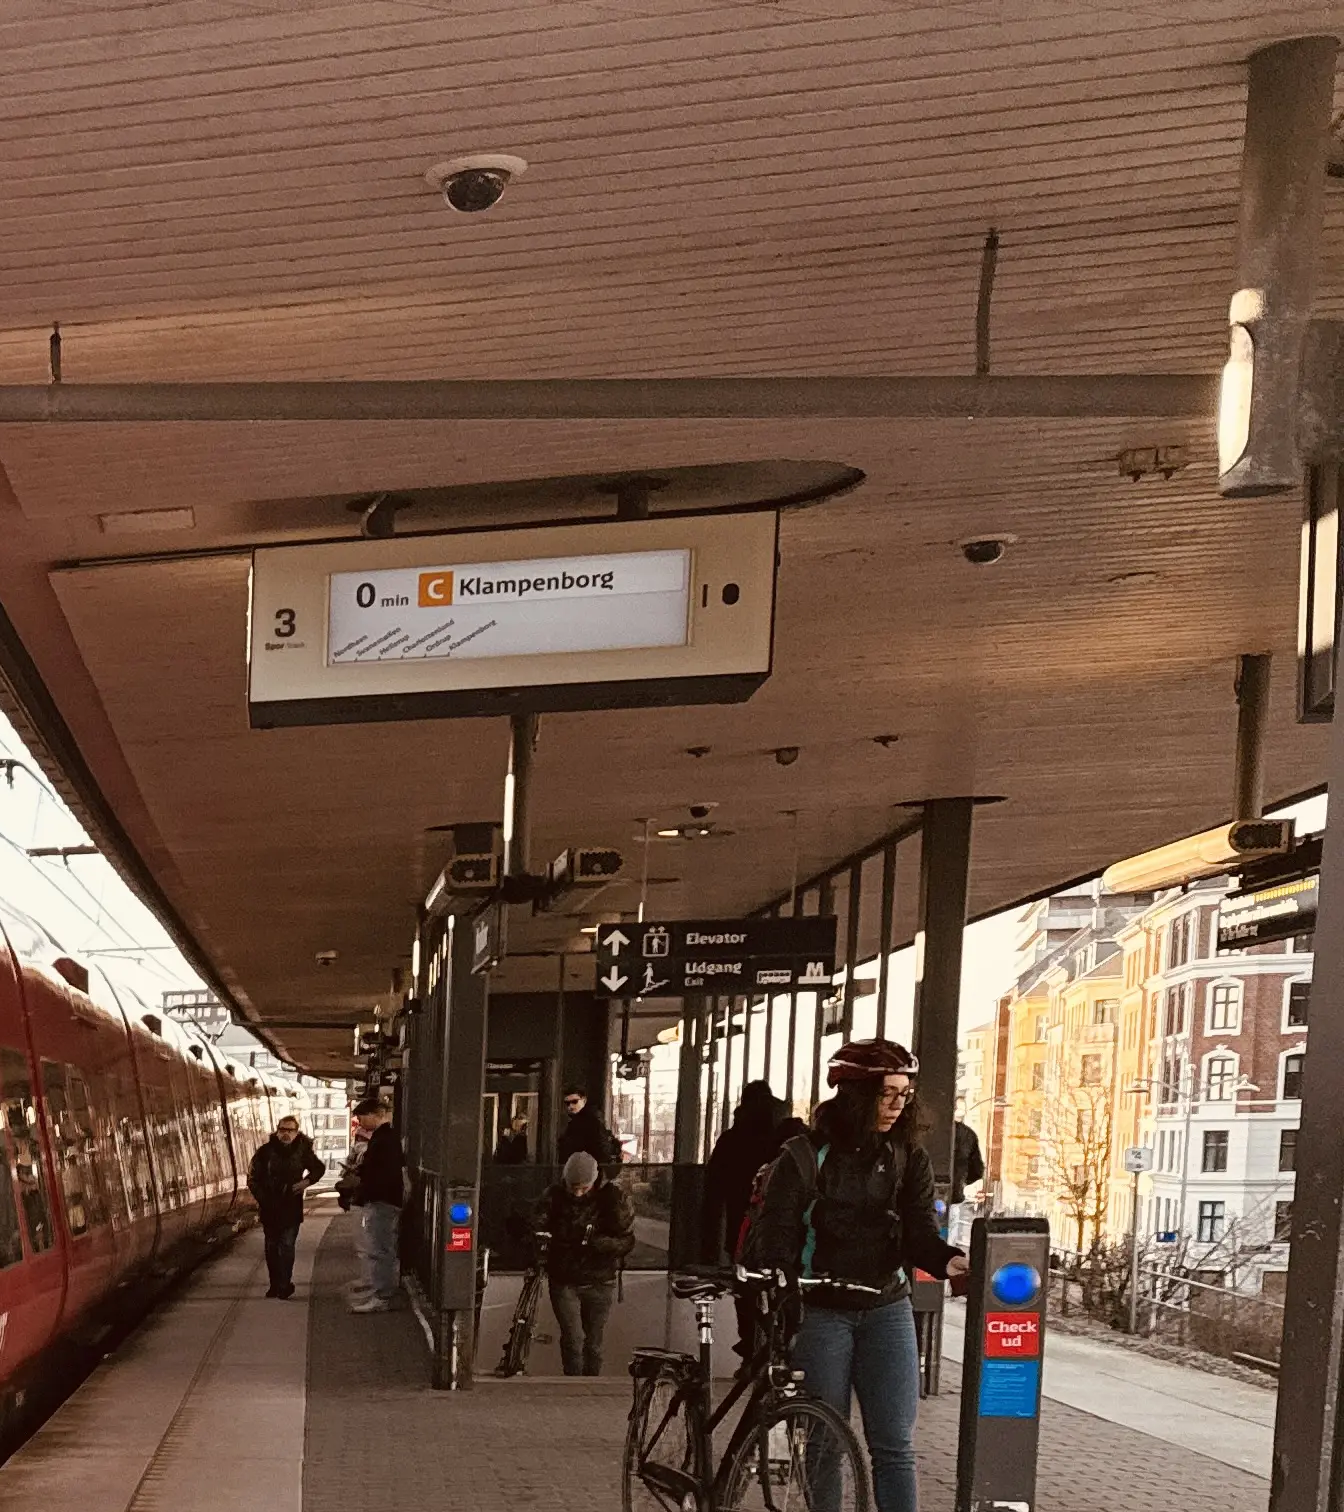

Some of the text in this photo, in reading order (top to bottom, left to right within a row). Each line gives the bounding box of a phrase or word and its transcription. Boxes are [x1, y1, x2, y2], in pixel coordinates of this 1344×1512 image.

[356, 571, 614, 608] 0 min C Klampenborg
[274, 608, 296, 638] 3
[449, 619, 497, 650] Klampenborg
[426, 634, 451, 652] Ordrup
[686, 932, 748, 945] Elevator
[684, 961, 743, 975] Udgang
[684, 977, 705, 987] Exit
[987, 1320, 1037, 1333] Check
[1001, 1335, 1022, 1347] ud
